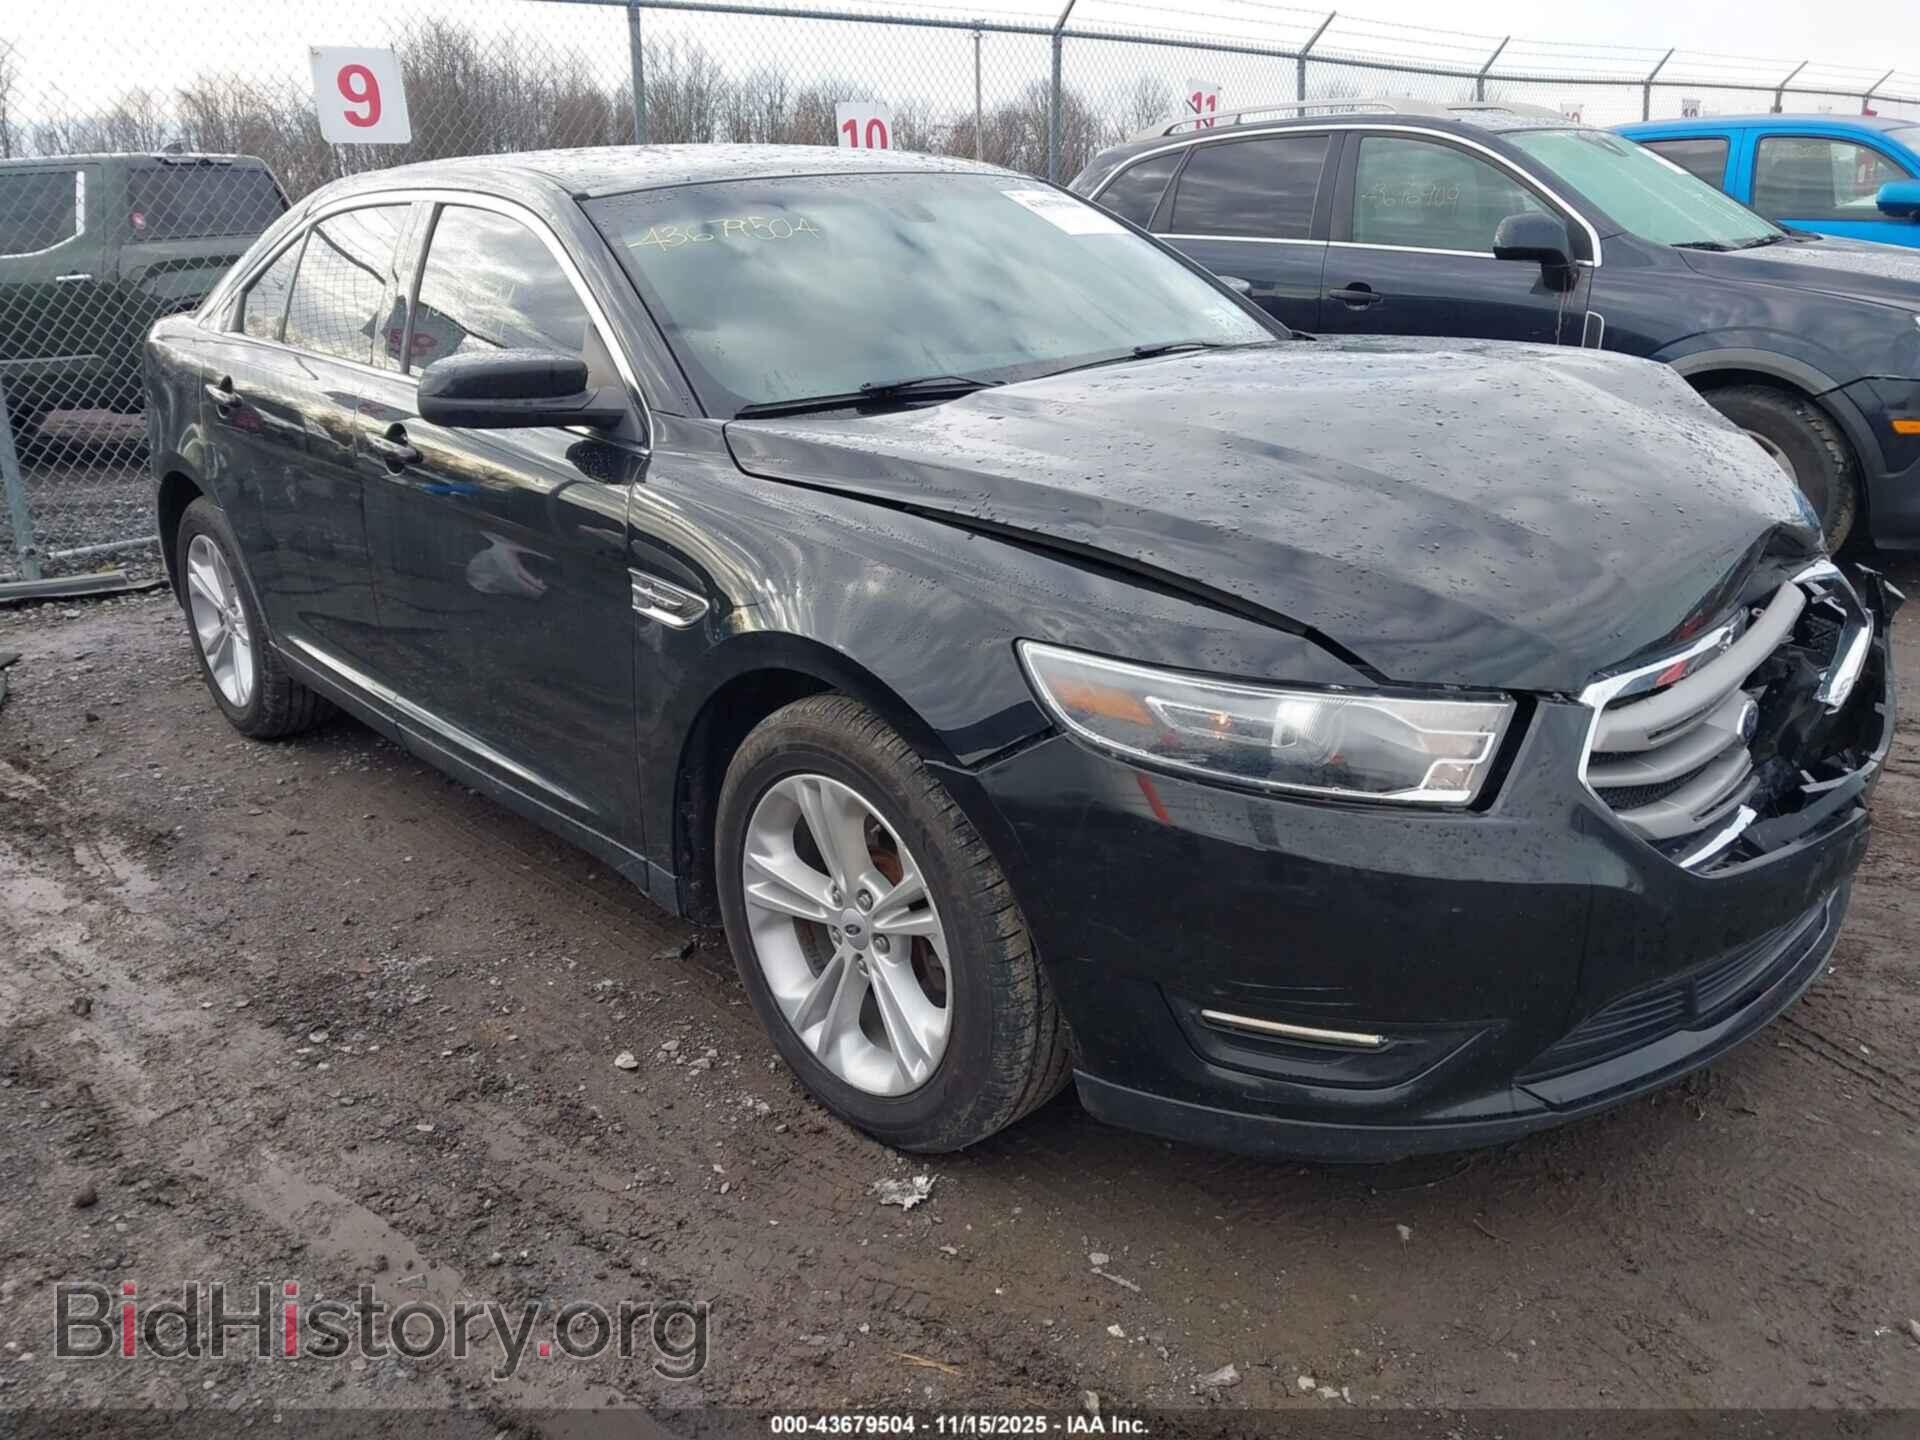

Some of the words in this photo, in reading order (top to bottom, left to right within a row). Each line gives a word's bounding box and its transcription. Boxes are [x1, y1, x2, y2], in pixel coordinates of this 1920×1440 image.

[337, 64, 382, 128] 9
[1192, 91, 1216, 128] 11
[842, 118, 888, 149] 10
